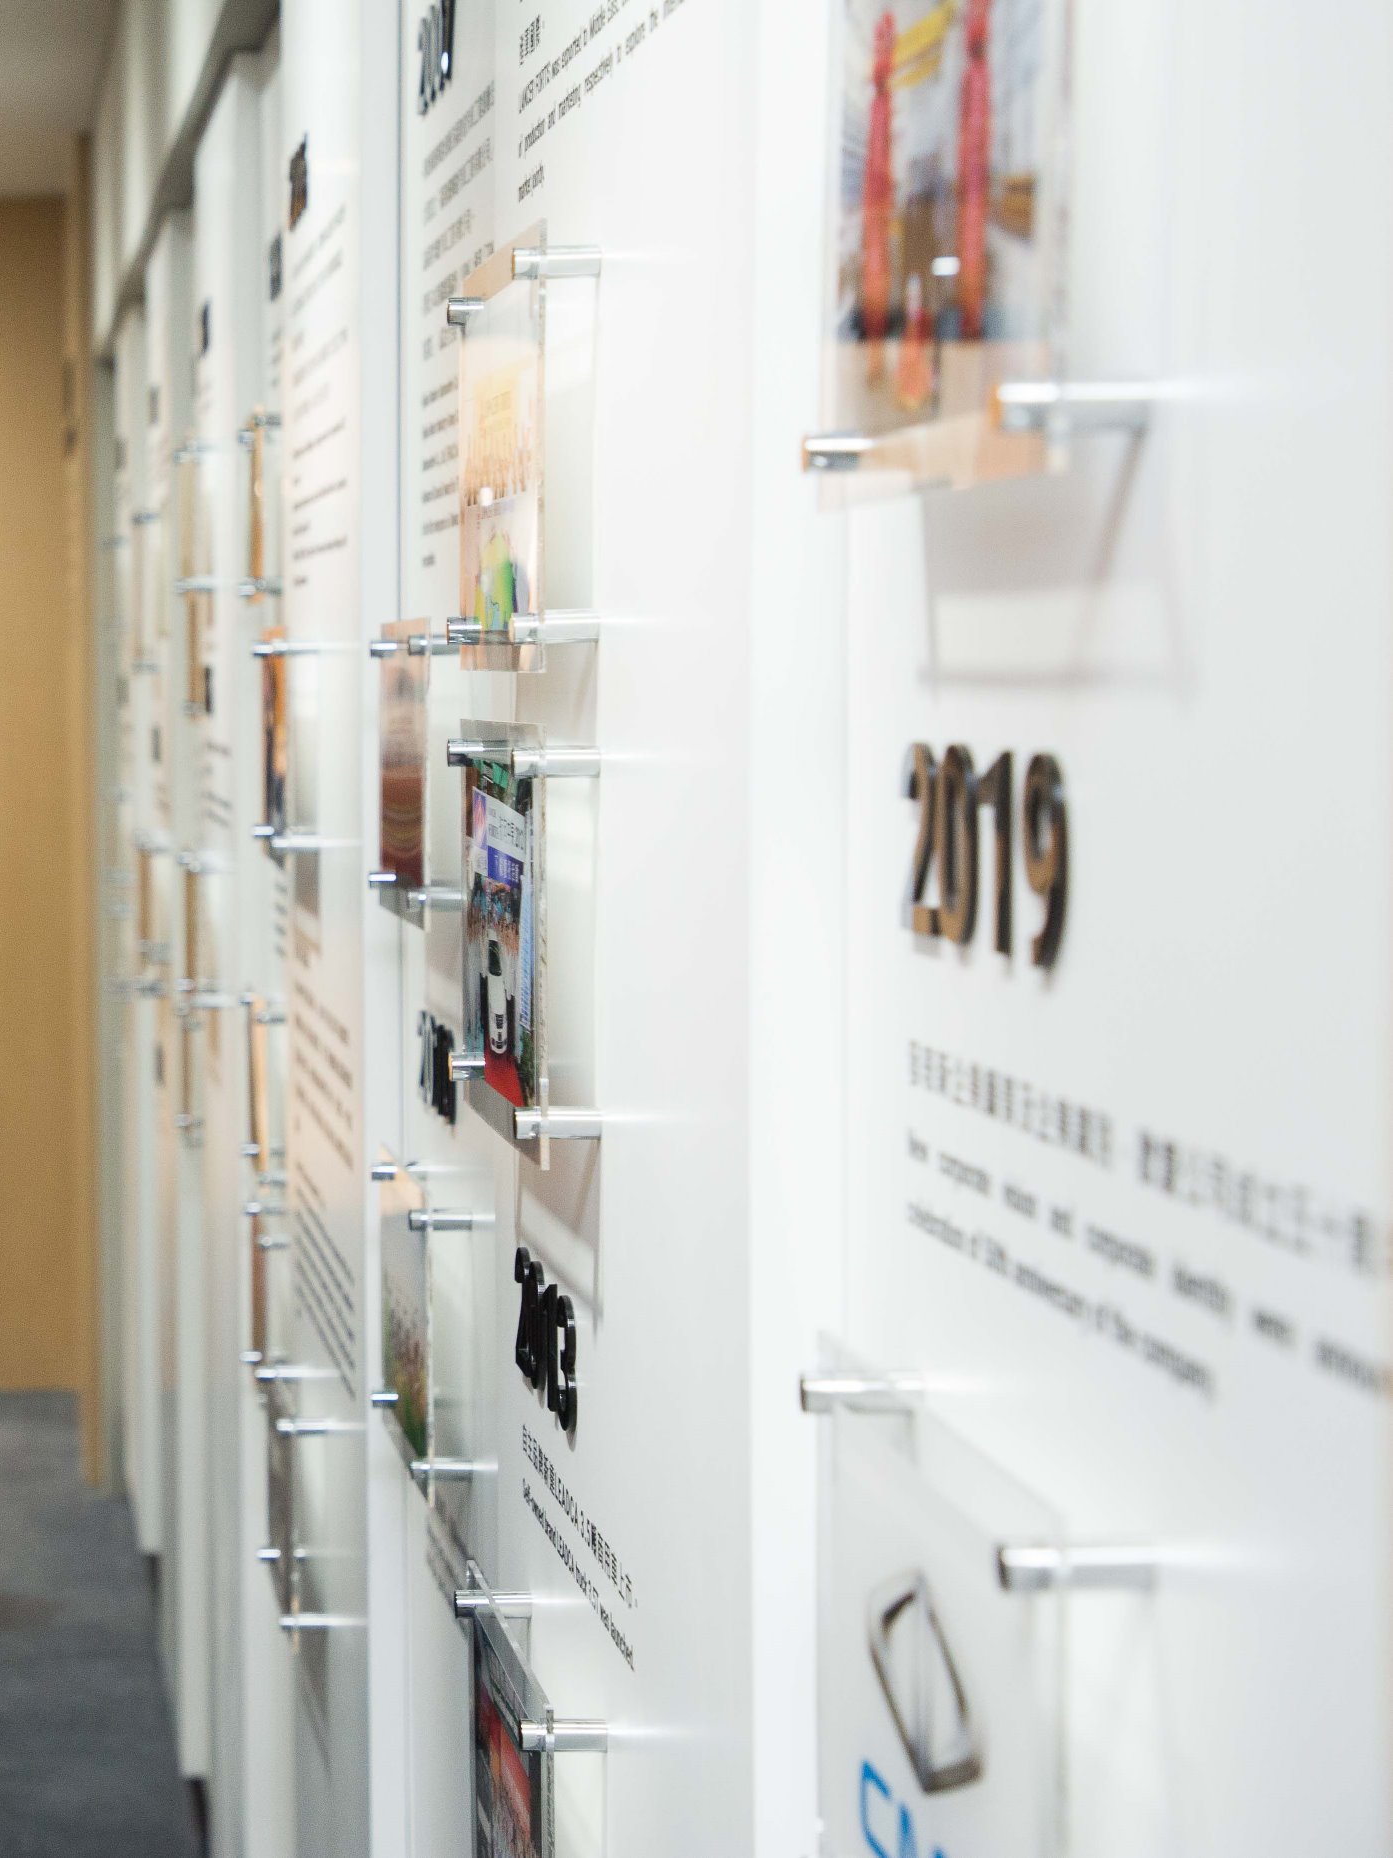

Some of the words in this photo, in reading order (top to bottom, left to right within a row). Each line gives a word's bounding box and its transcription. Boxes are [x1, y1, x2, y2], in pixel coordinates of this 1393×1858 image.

[903, 742, 1071, 970] 2019
[514, 1246, 578, 1432] 2013
[599, 1602, 610, 1633] was
